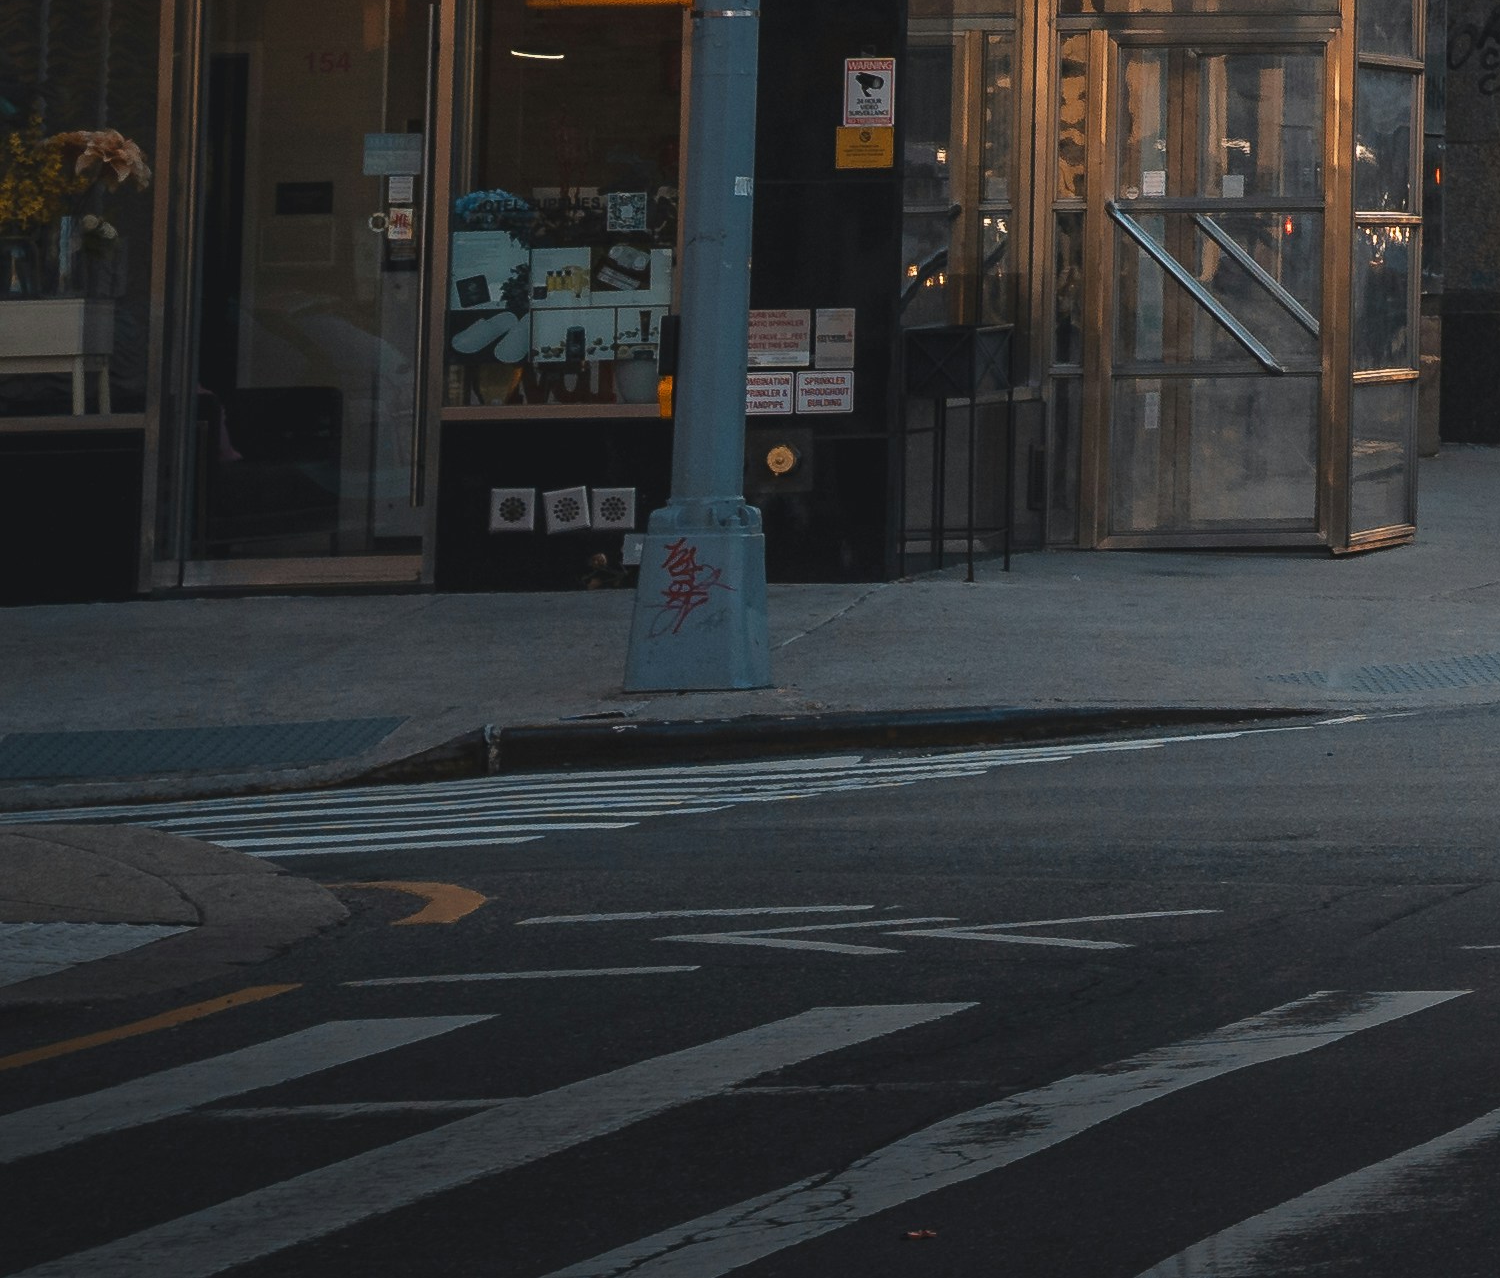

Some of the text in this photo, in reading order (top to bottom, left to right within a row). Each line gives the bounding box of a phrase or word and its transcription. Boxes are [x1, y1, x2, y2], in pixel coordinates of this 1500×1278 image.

[848, 61, 893, 71] WARNING
[746, 377, 790, 386] OMBINATION
[804, 376, 846, 385] SPRINKLER
[746, 389, 781, 397] PRINKLER
[800, 387, 850, 396] THROUGHOUT
[807, 398, 842, 407] BUILDING
